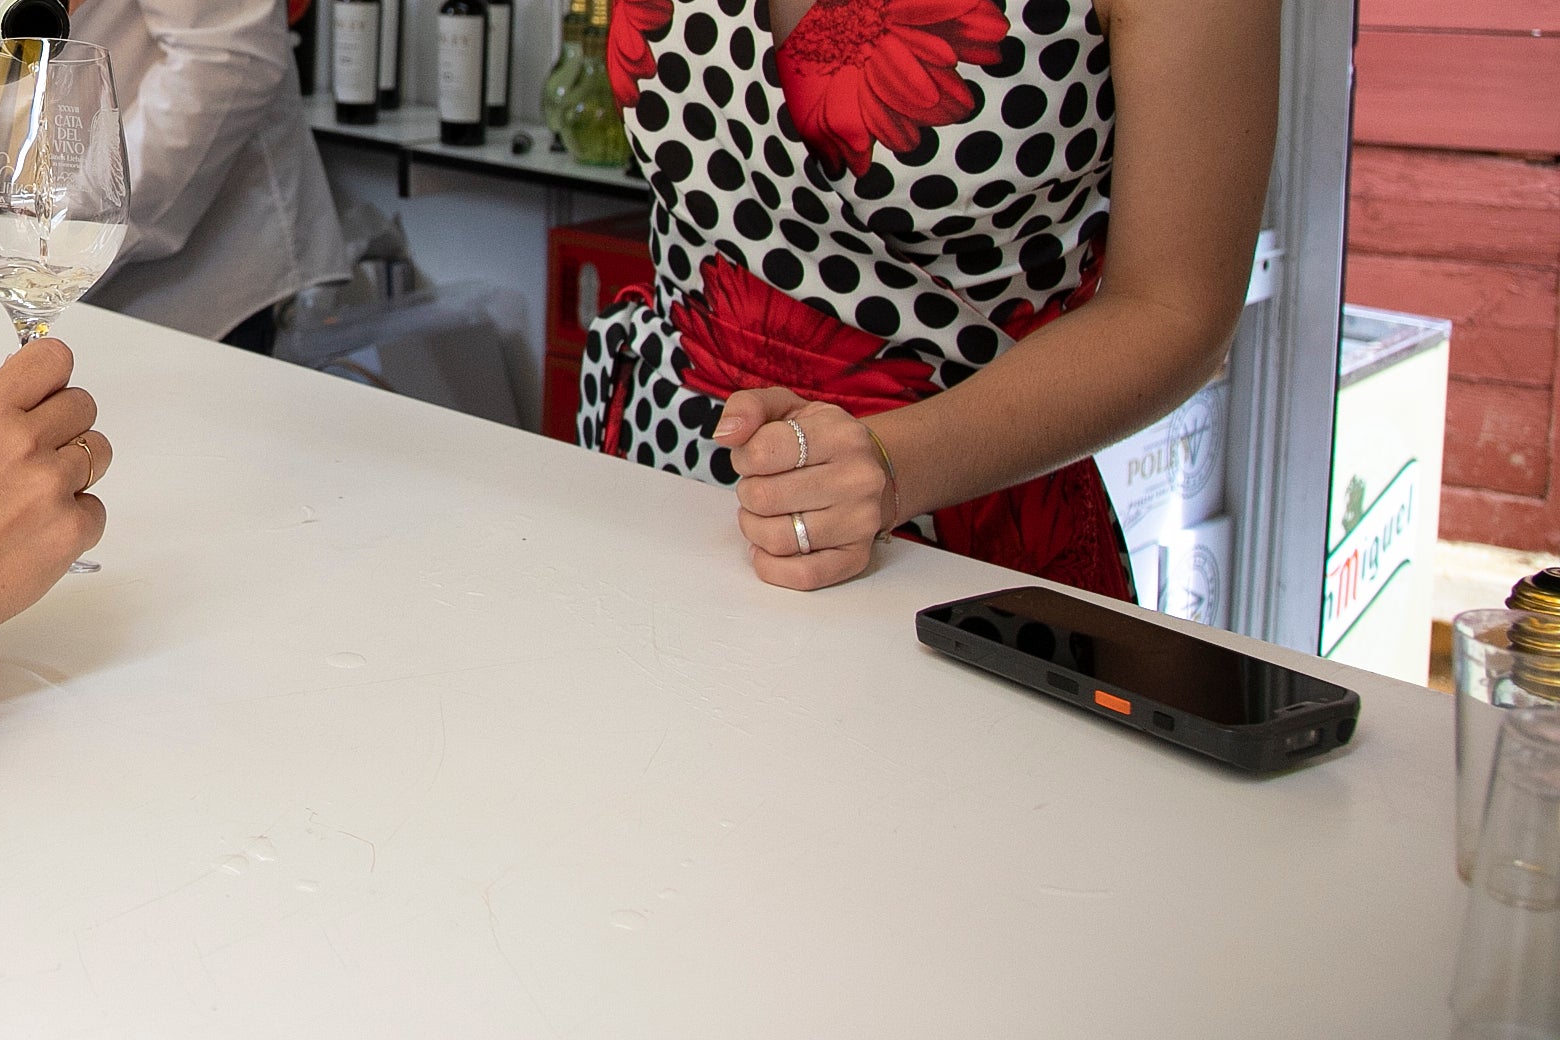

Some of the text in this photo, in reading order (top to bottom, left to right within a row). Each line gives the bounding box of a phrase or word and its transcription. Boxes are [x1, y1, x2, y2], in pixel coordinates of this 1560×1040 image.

[54, 114, 83, 129] CATA
[57, 127, 81, 142] DEL
[53, 139, 85, 155] VINO
